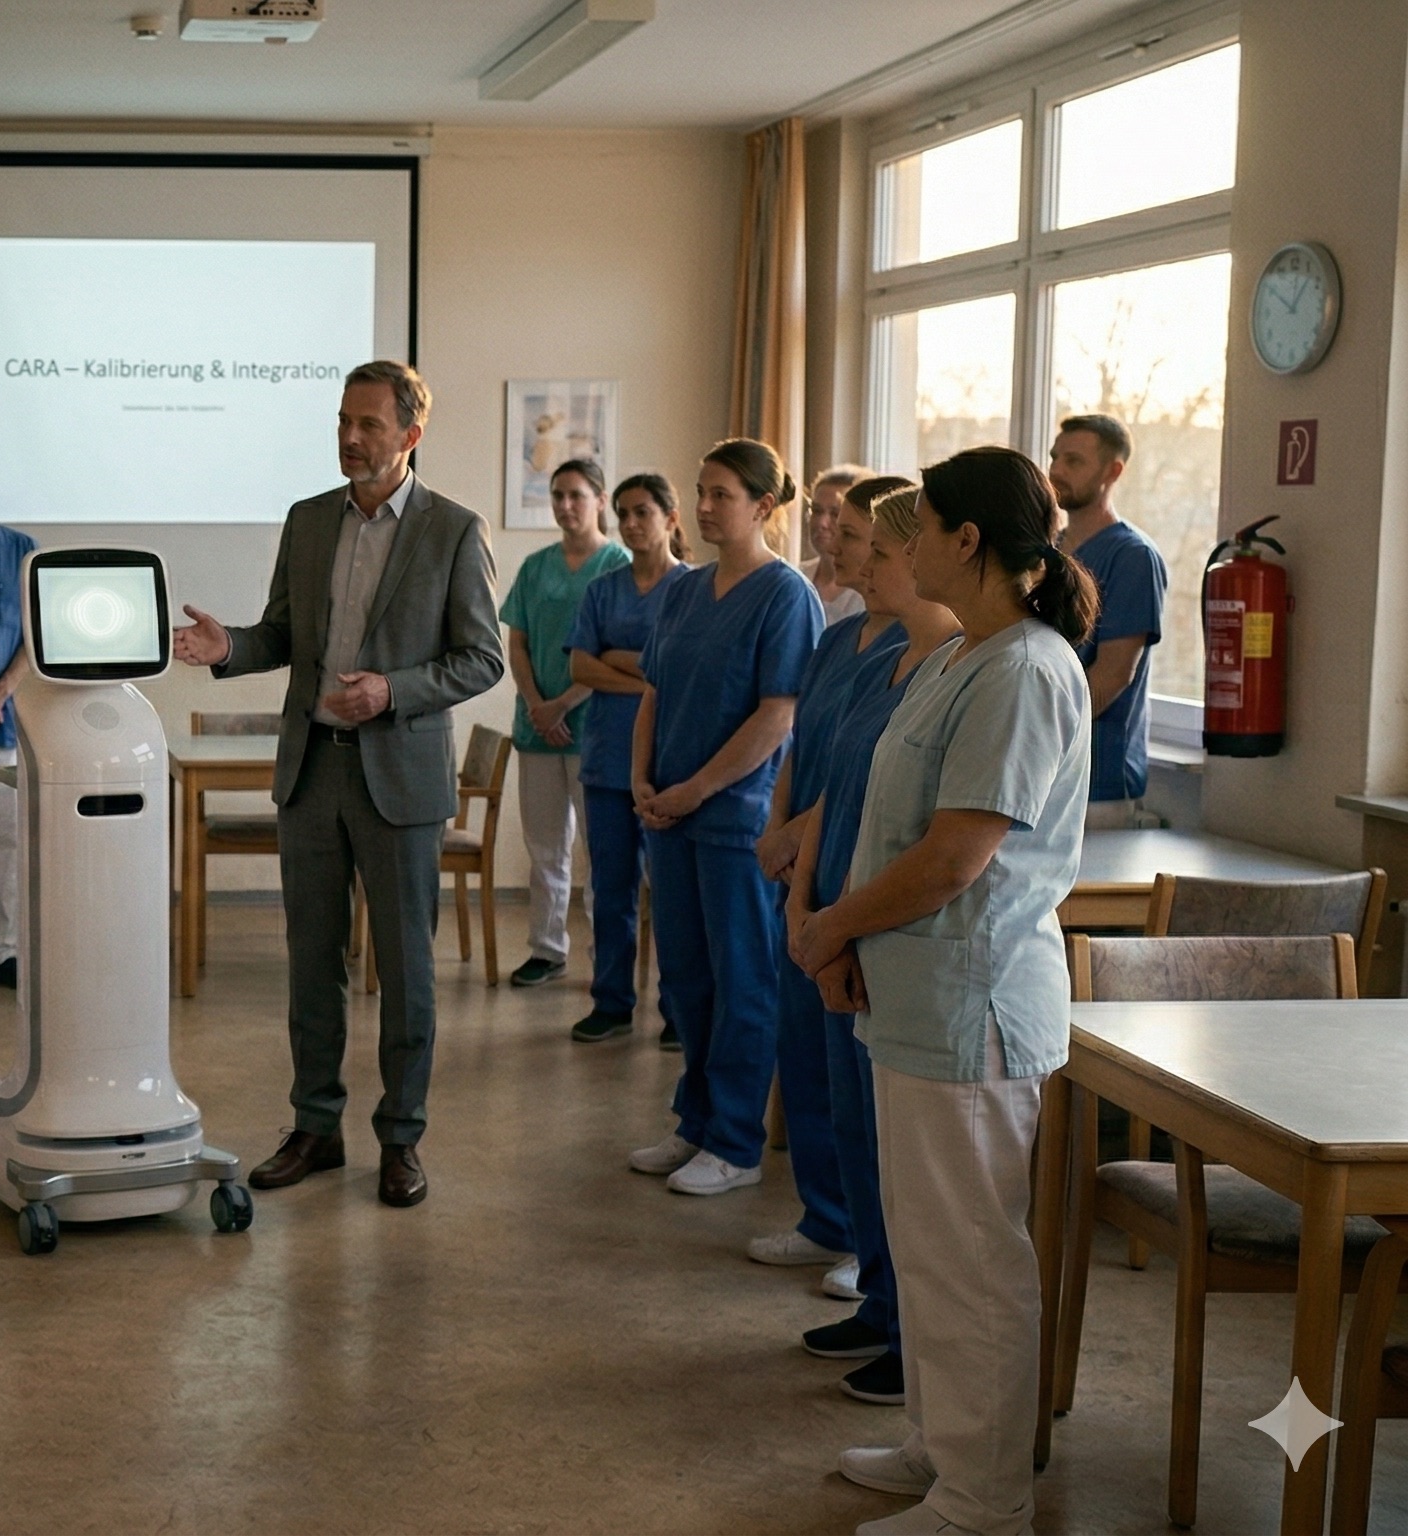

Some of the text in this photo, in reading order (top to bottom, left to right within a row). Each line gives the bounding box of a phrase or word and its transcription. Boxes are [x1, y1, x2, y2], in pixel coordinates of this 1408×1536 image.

[5, 358, 59, 378] CARA
[84, 359, 204, 382] Kalibrierung
[210, 360, 225, 379] &
[232, 360, 340, 383] Integration
